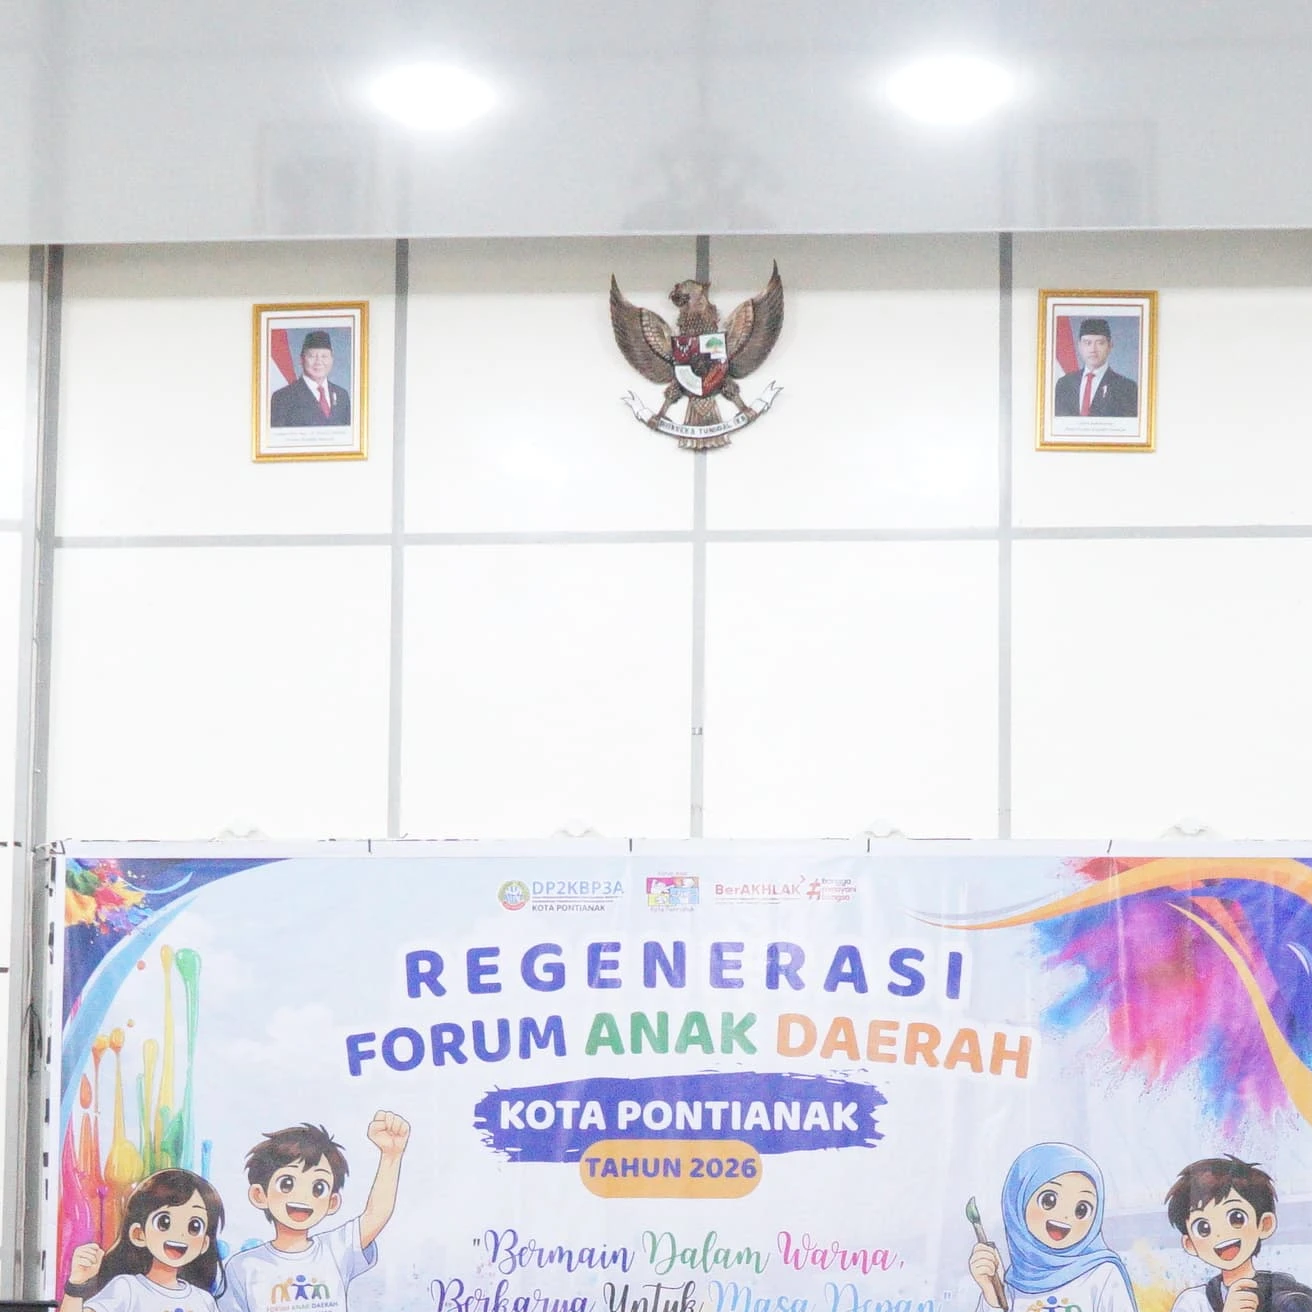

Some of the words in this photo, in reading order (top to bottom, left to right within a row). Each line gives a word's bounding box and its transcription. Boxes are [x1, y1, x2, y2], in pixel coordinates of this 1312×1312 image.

[532, 881, 624, 895] DP2KBP3A
[715, 883, 801, 896] BerAKHLAK
[532, 904, 554, 912] KOTA
[556, 904, 606, 912] PONTIANAK
[404, 940, 964, 1000] REGENERASI
[344, 1014, 568, 1078] FORUM
[584, 1010, 759, 1056] ANAK
[775, 1012, 1033, 1080] DAERAH
[499, 1099, 609, 1131] KOTA
[617, 1099, 860, 1133] PONTIANAK
[584, 1156, 683, 1180] TAHUN
[688, 1156, 758, 1180] 2026
[641, 1229, 771, 1276] Dalam
[776, 1230, 906, 1272] Warna,
